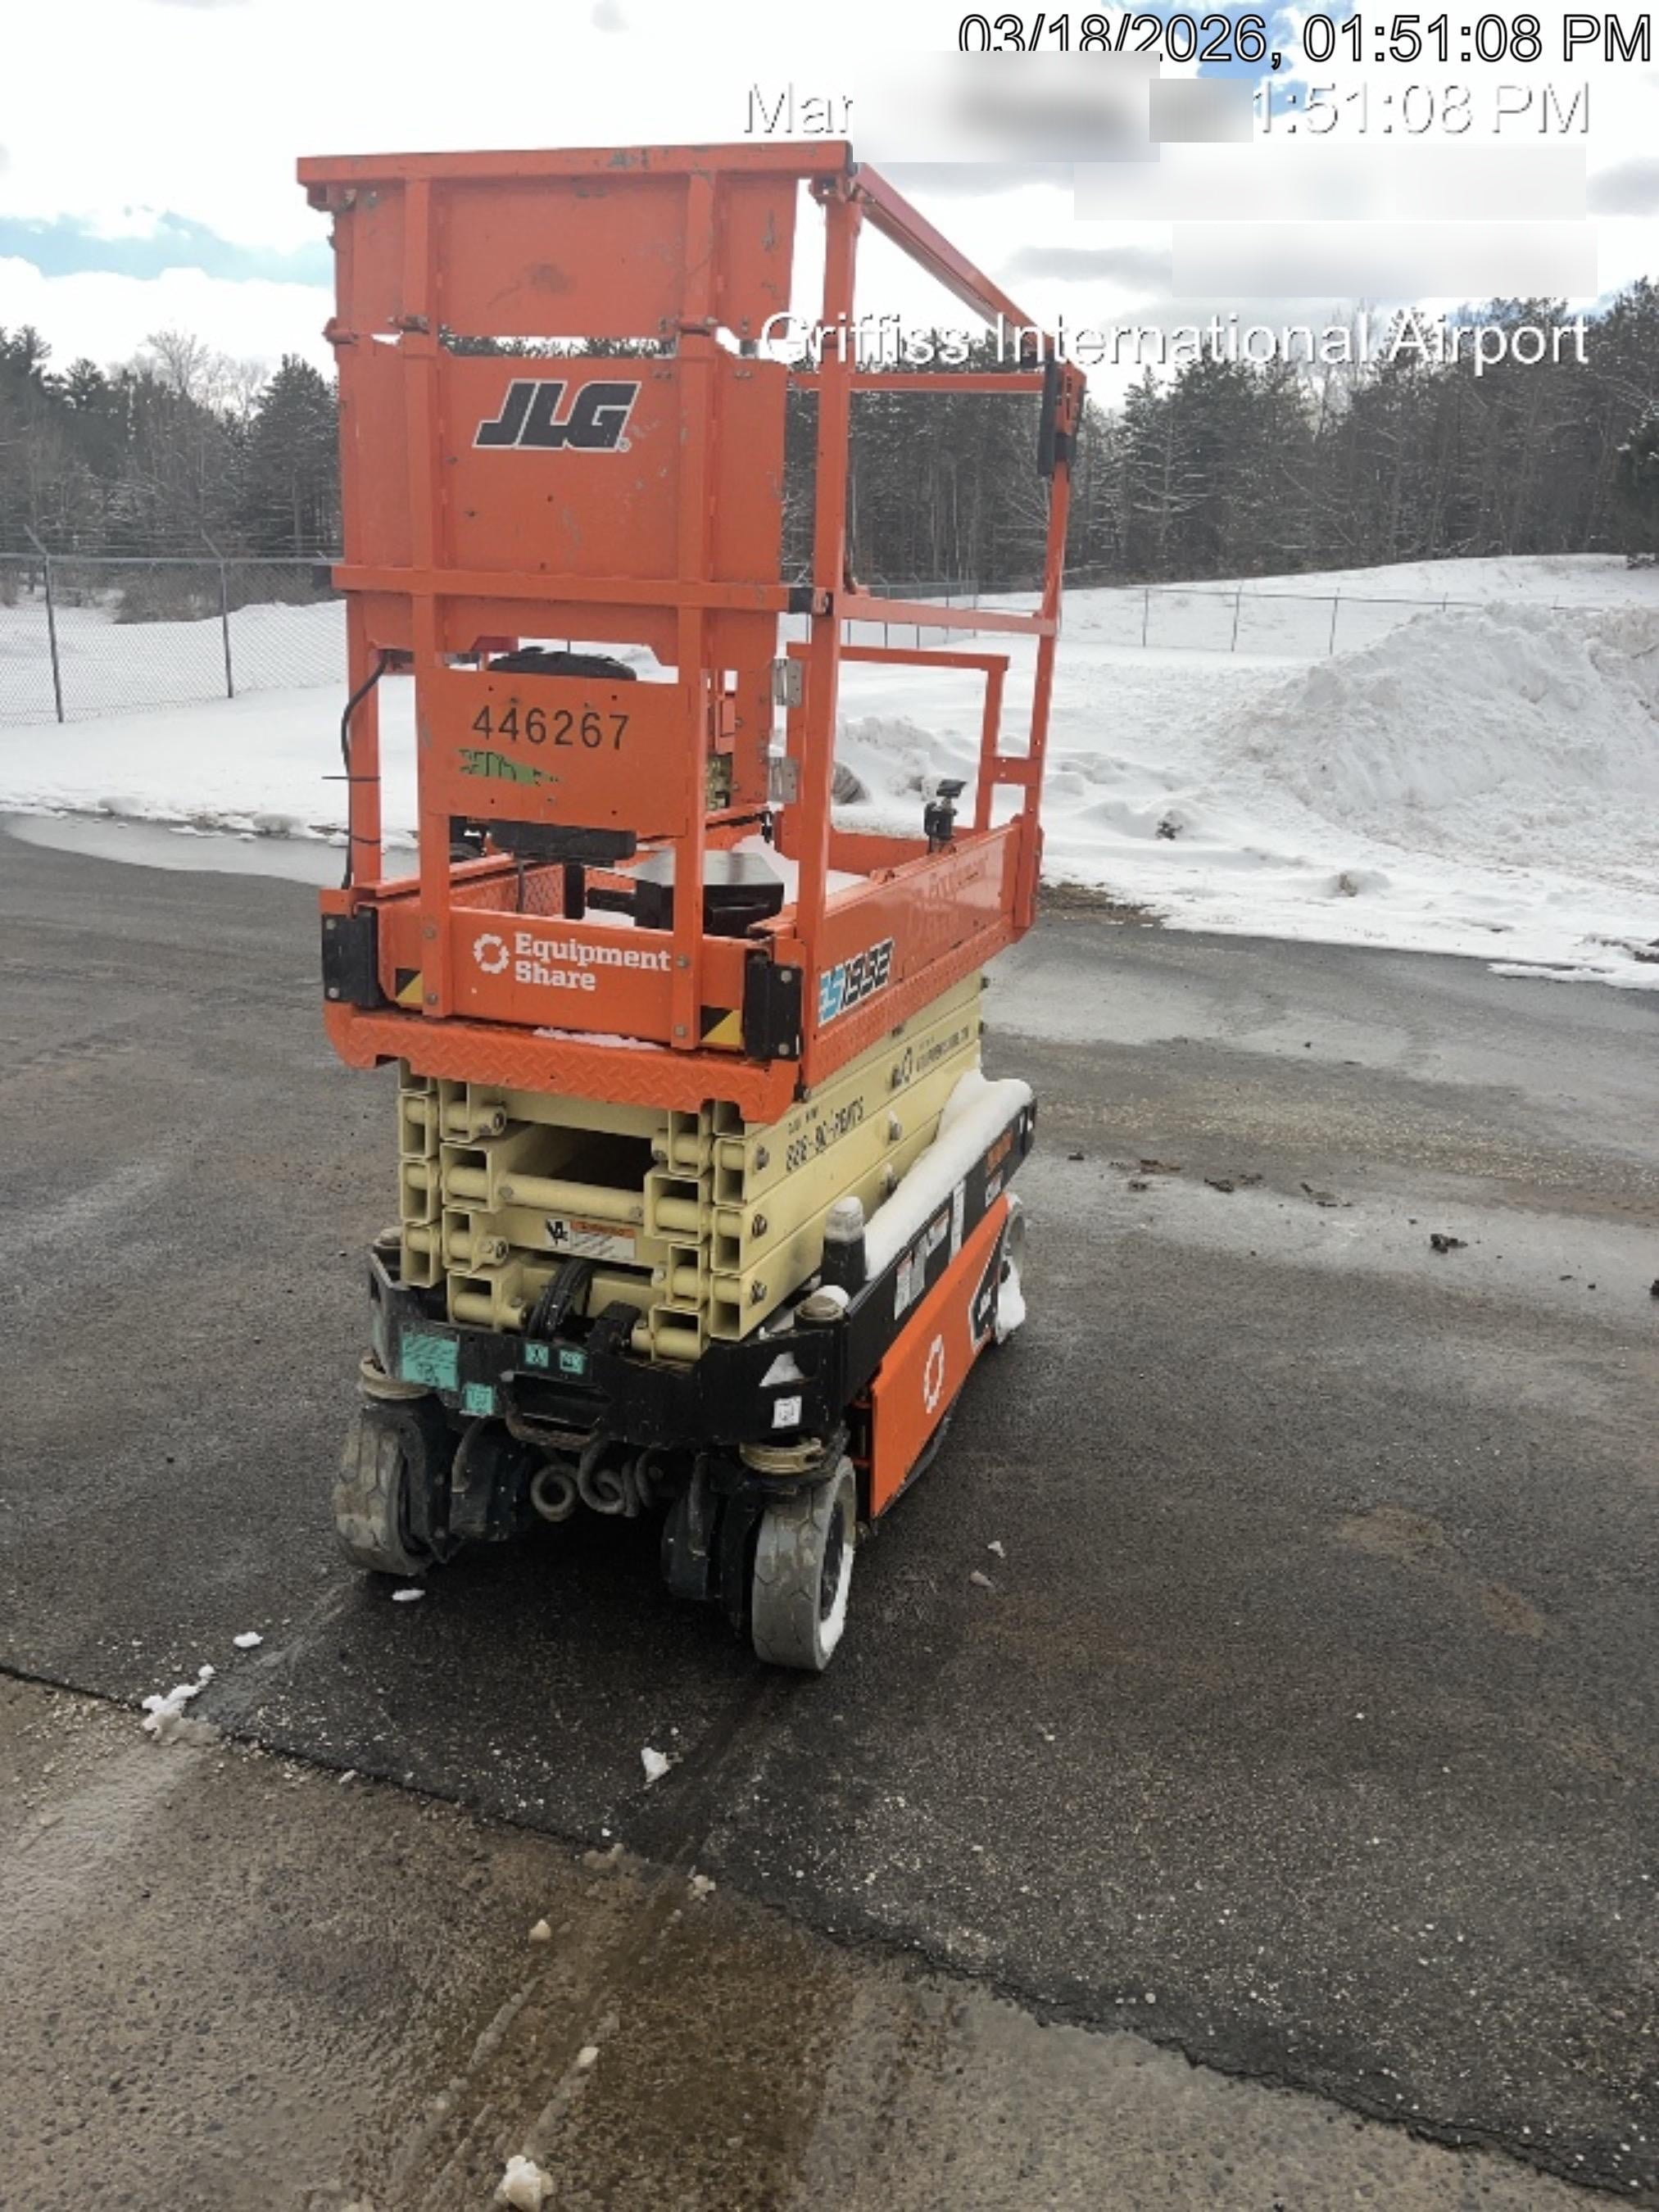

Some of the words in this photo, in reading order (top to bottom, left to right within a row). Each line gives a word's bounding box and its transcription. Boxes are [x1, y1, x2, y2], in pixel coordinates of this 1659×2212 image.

[472, 378, 641, 452] JLG
[473, 705, 629, 750] 446267
[514, 931, 671, 972] Equipment
[514, 960, 596, 990] Share
